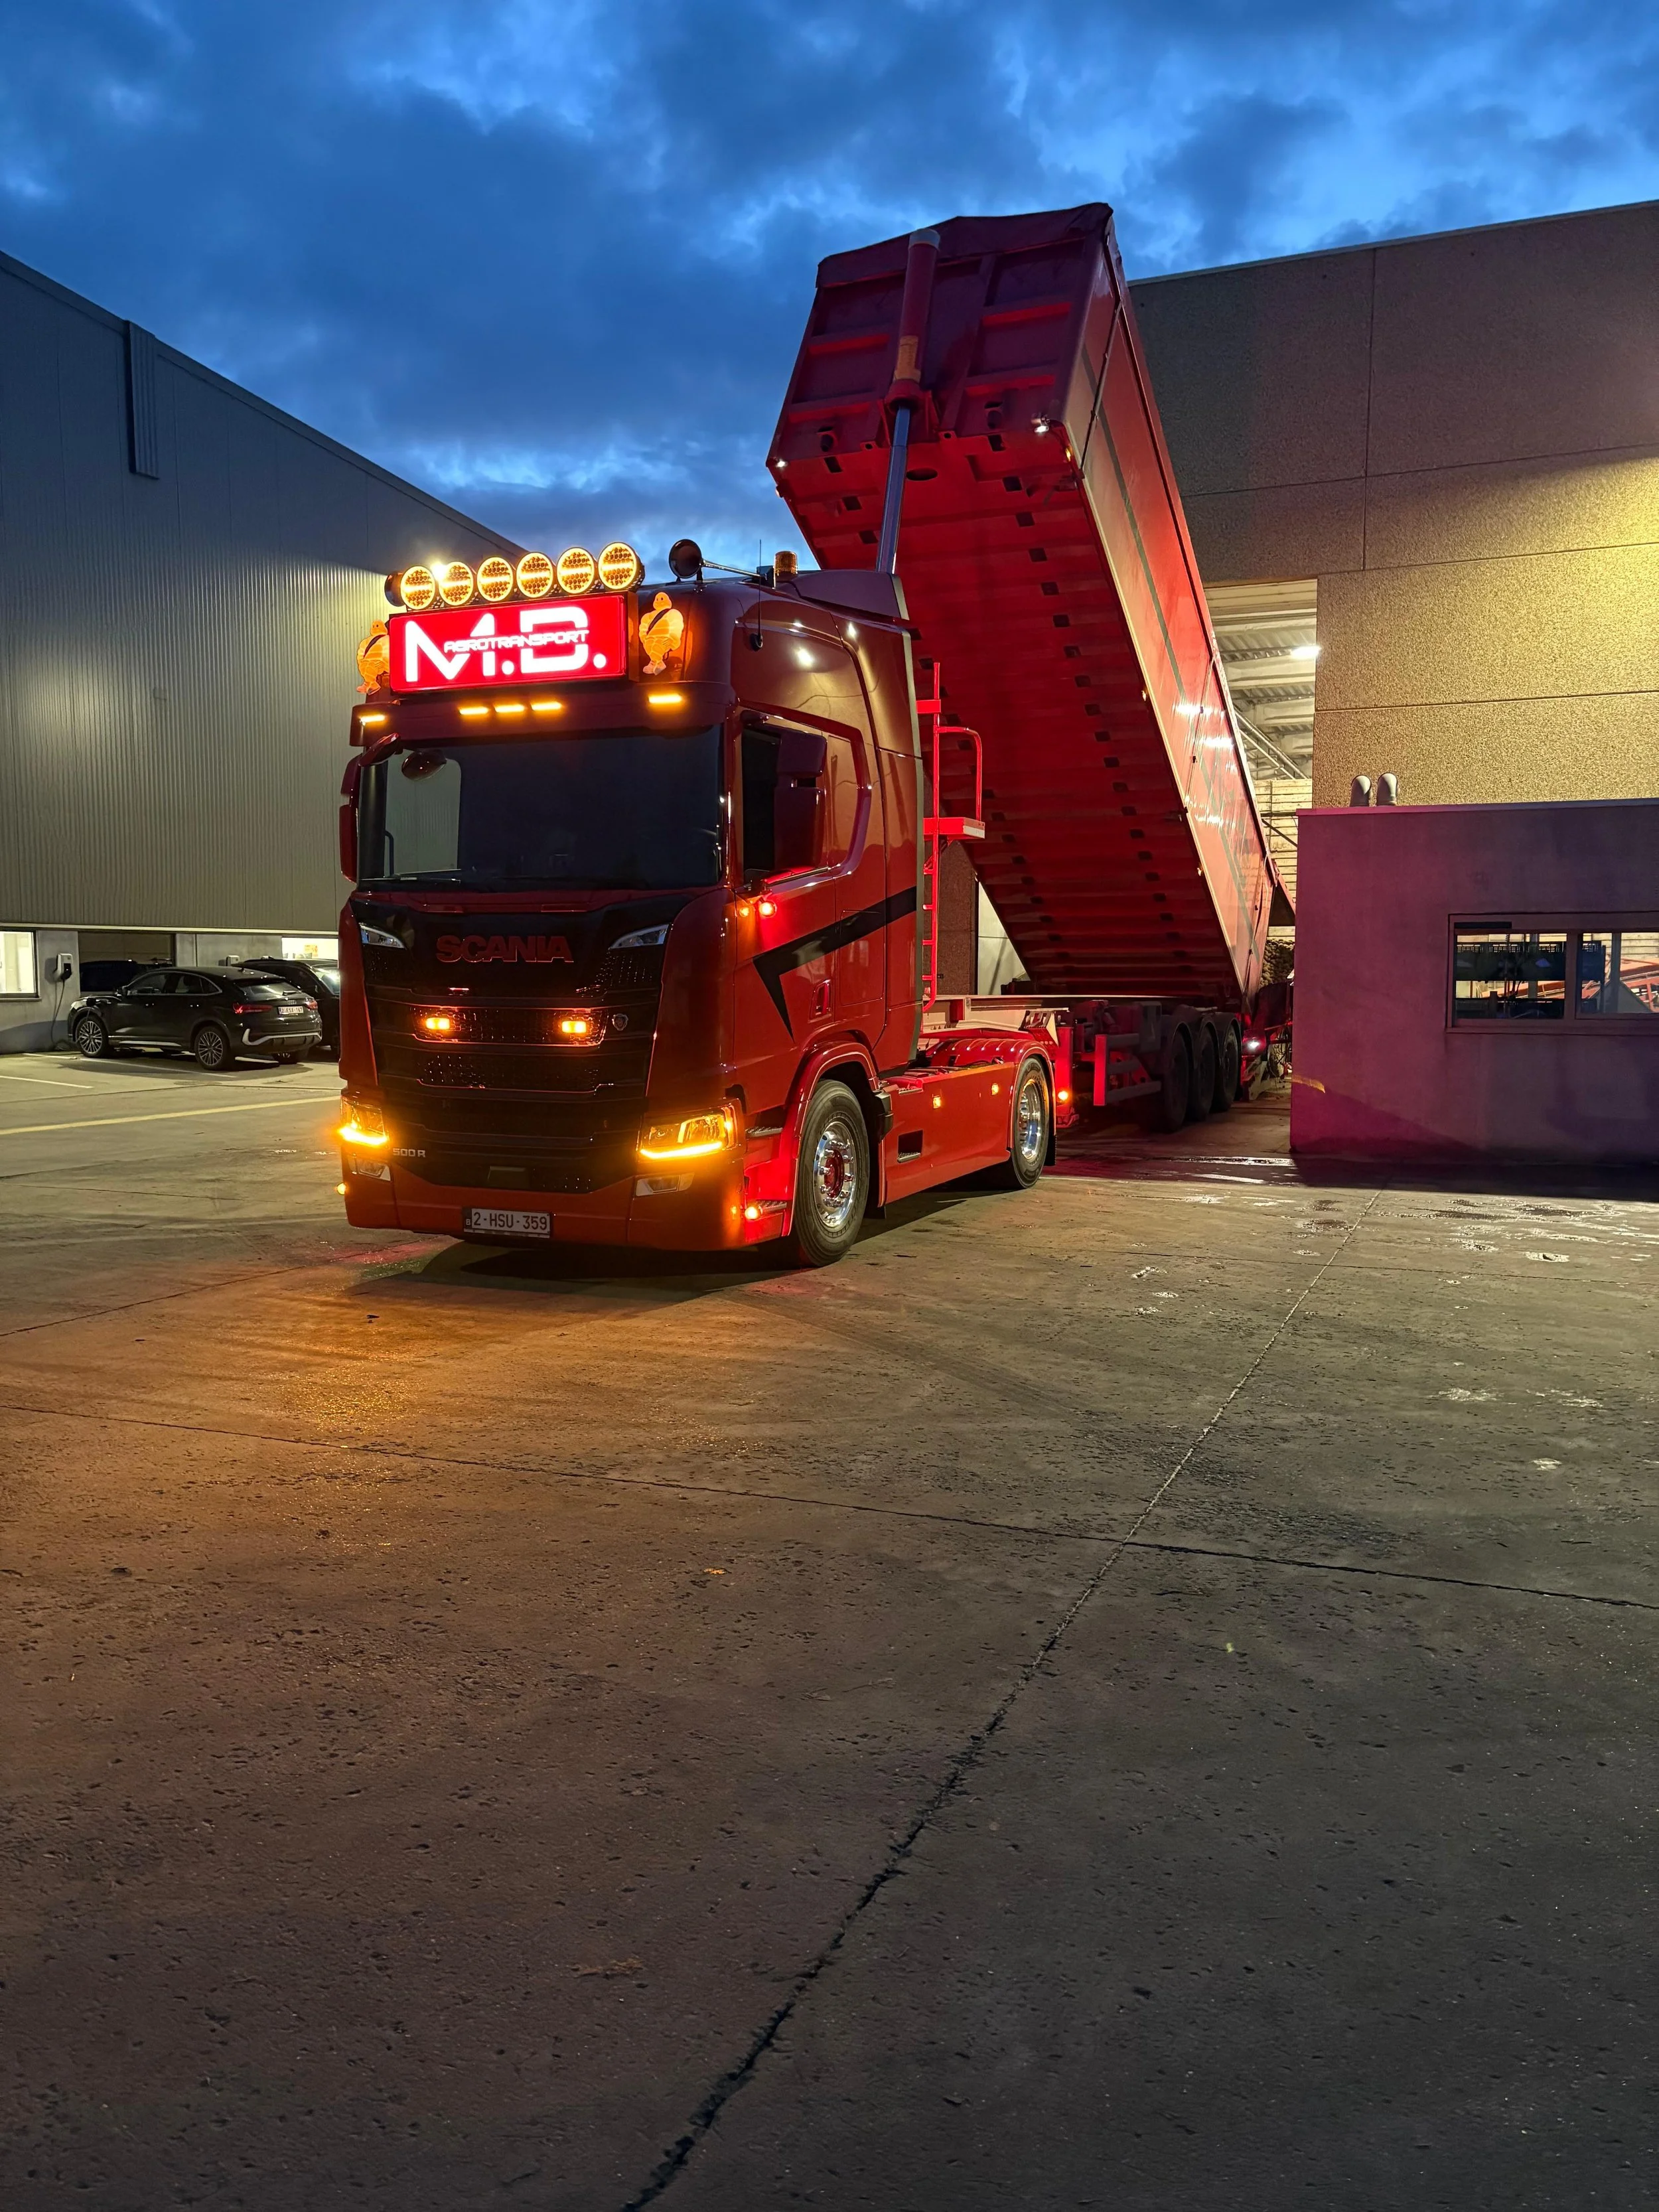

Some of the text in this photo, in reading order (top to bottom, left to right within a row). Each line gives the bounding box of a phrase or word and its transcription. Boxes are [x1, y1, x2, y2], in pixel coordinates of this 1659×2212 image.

[443, 629, 589, 653] AGROTRANSPORT
[436, 934, 574, 962] SCANIA
[473, 1211, 547, 1230] 2-HSU-359
